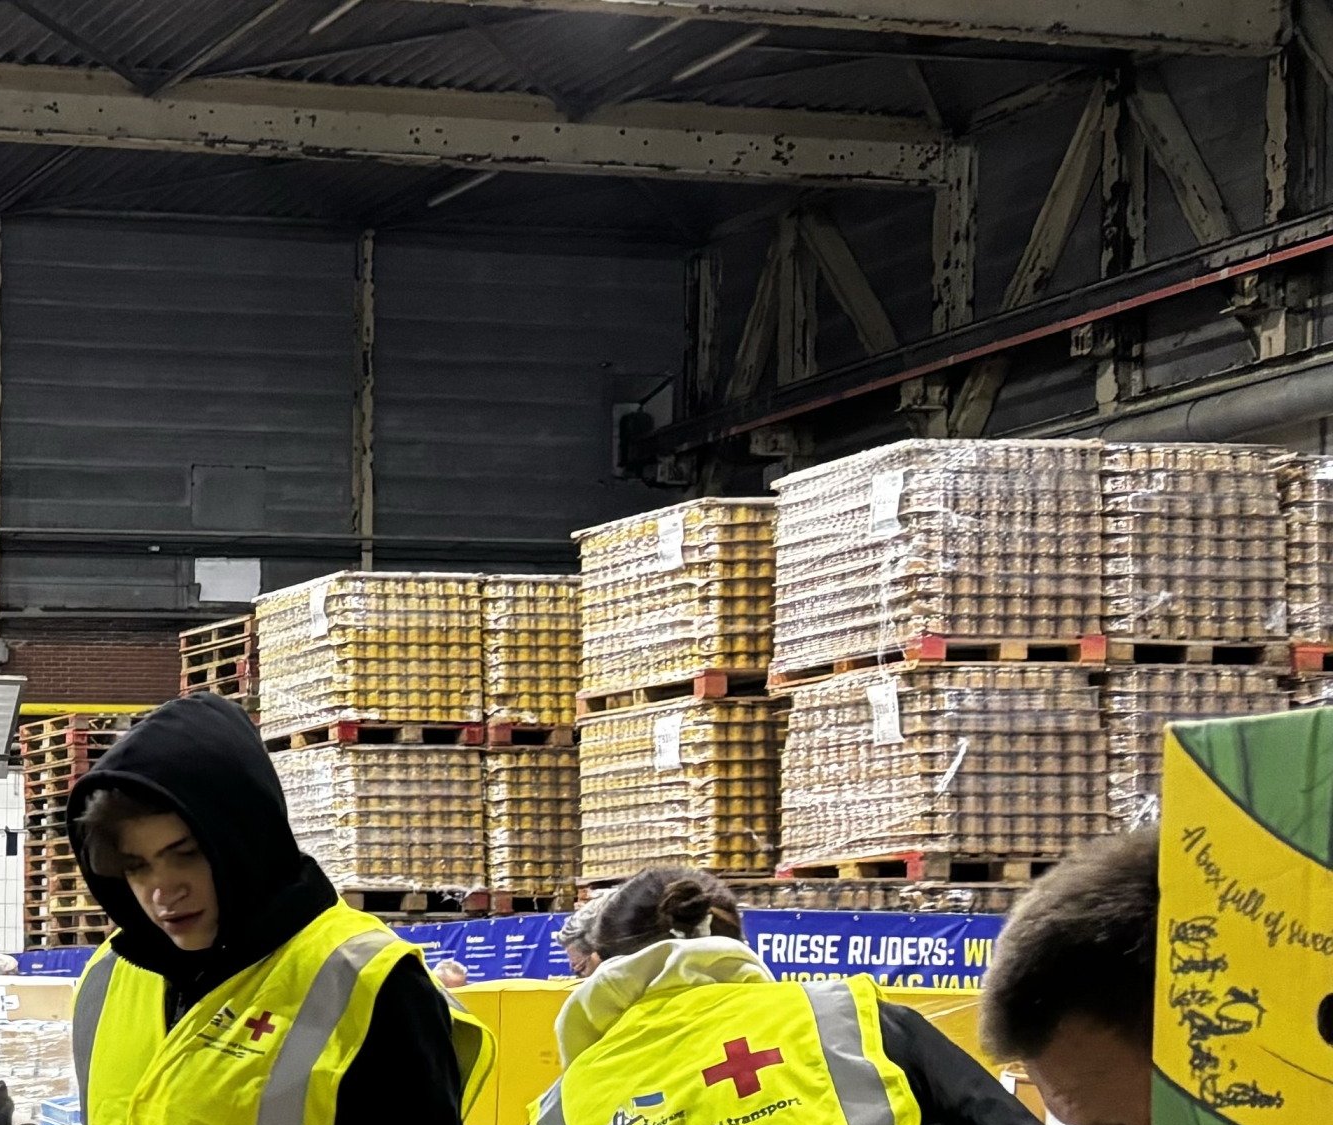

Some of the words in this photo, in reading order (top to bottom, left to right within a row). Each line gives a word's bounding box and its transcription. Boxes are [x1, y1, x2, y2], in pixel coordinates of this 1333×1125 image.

[1195, 842, 1228, 890] box
[1218, 879, 1267, 922] full
[1263, 910, 1287, 948] of
[757, 933, 841, 965] FRIESE
[847, 935, 956, 967] RIJDERS:
